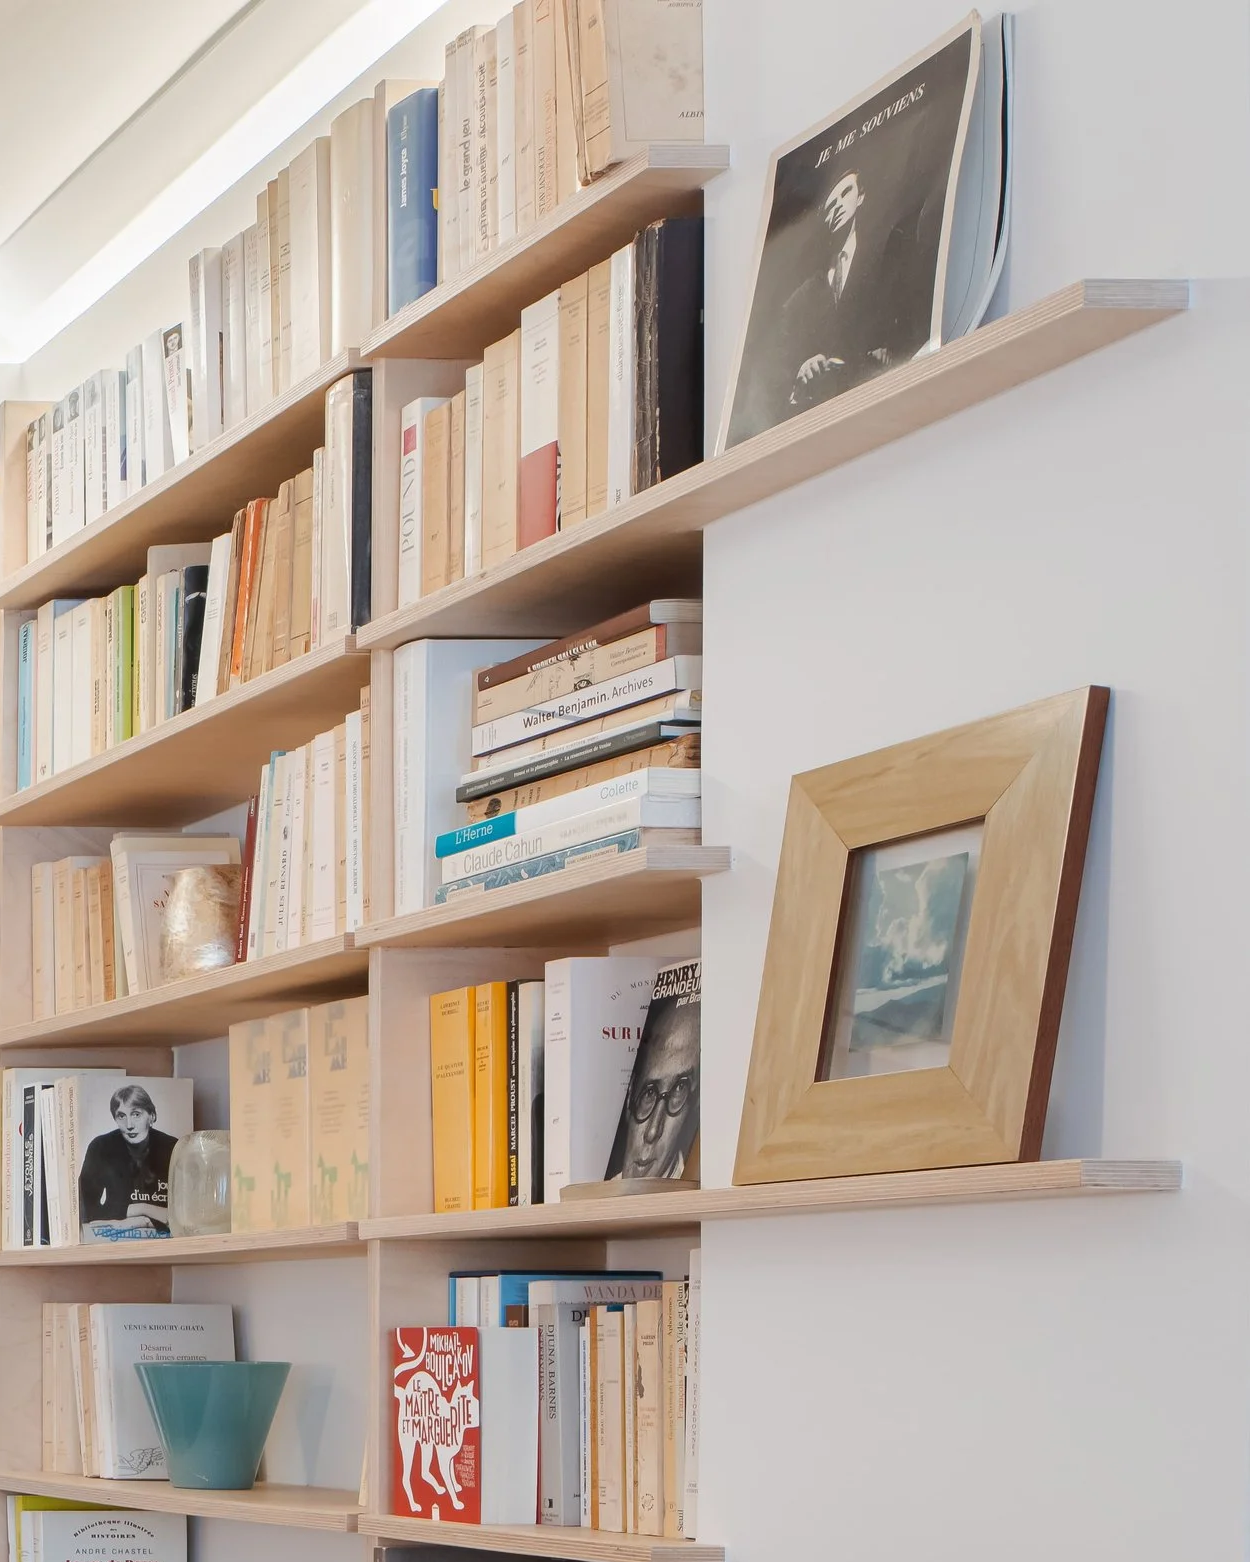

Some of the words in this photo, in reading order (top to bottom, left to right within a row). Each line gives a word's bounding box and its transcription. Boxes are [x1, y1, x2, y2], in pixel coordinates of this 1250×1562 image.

[462, 118, 473, 136] jeu
[814, 145, 833, 169] JE
[835, 129, 857, 155] ME
[859, 82, 926, 138] SOUVIENS
[400, 147, 409, 176] Joyce
[459, 139, 472, 176] grand
[479, 143, 488, 183] GUERRE
[400, 177, 408, 208] James
[459, 178, 470, 192] le
[479, 184, 487, 197] DE
[479, 198, 488, 240] LETTRES
[401, 457, 415, 553] POUND
[21, 626, 29, 664] JOURNAL
[523, 710, 556, 729] Walter
[558, 692, 610, 719] Benjamin.
[612, 675, 654, 699] Archives
[600, 778, 639, 801] Colette
[455, 824, 493, 845] L'Herne
[464, 849, 502, 874] Claude
[505, 836, 543, 862] Cahun
[279, 850, 288, 890] RENARD
[277, 895, 286, 926] JULES
[656, 962, 698, 987] HENRY
[652, 977, 701, 1000] GRANDEU
[676, 997, 689, 1009] par
[602, 1026, 631, 1040] SUR
[130, 1189, 150, 1201] d'un
[151, 1192, 169, 1202] écr
[583, 1284, 639, 1299] WANDA
[643, 1284, 662, 1298] DE
[675, 1285, 684, 1308] plein
[547, 1323, 556, 1365] DJUNA
[675, 1323, 683, 1343] Vide
[140, 1343, 172, 1352] Désarroi
[140, 1353, 154, 1361] des
[155, 1353, 175, 1361] âmes
[425, 1343, 474, 1391] BOULGAKOV
[676, 1347, 686, 1377] Cheng
[413, 1379, 421, 1392] LE
[548, 1371, 556, 1420] BARNES
[676, 1379, 685, 1420] François
[402, 1419, 410, 1434] ET
[411, 1394, 472, 1448] MARGUERITE
[676, 1509, 684, 1532] Seuil
[75, 1547, 106, 1555] ANDRÉ
